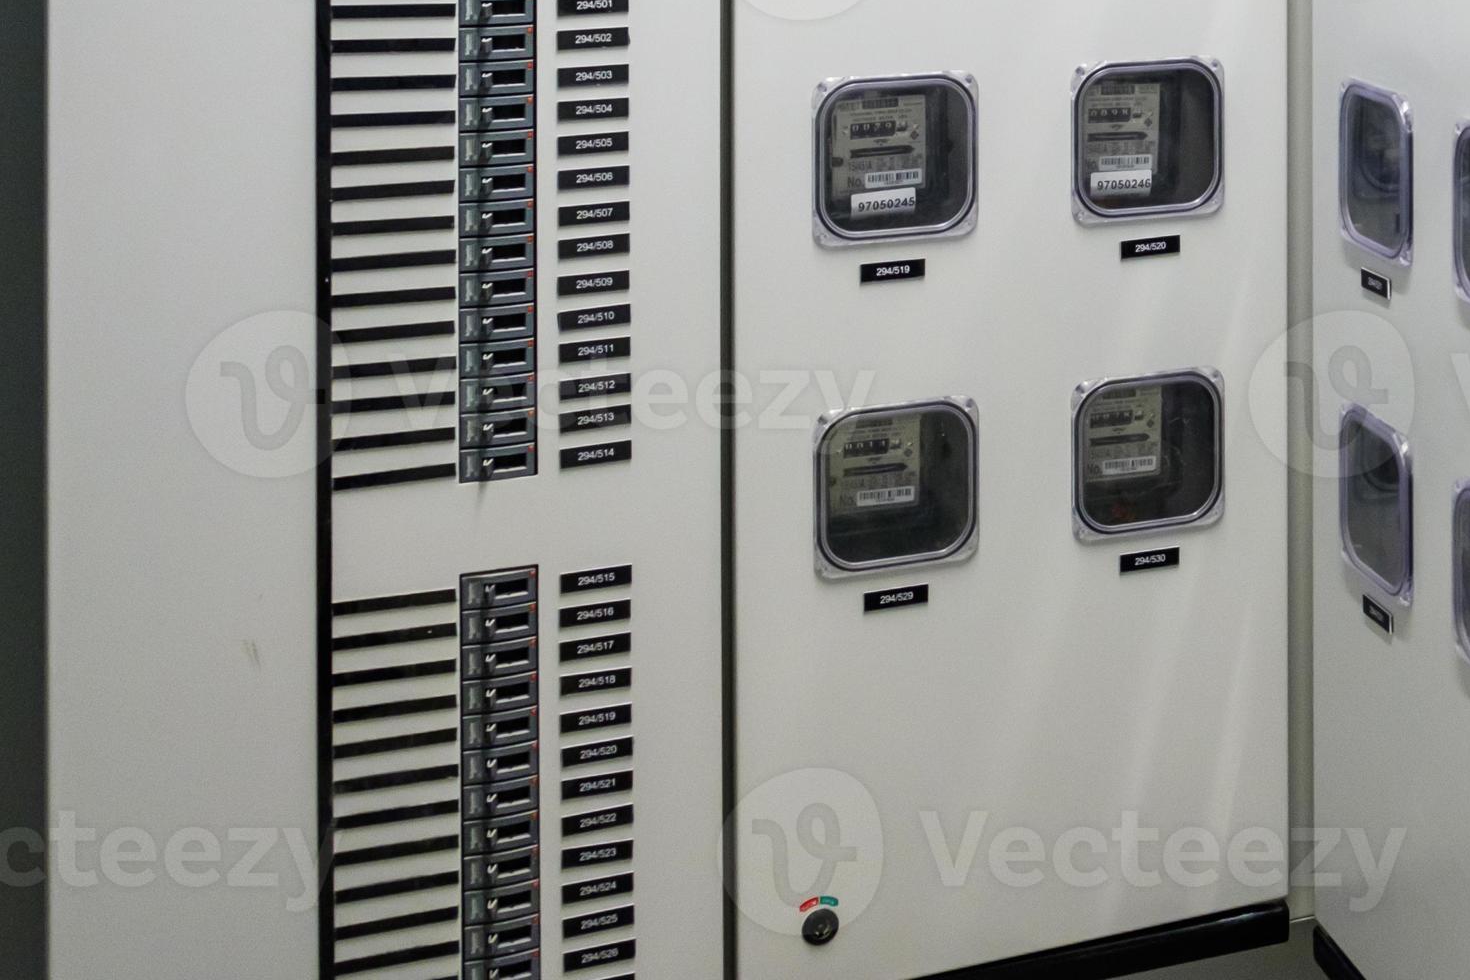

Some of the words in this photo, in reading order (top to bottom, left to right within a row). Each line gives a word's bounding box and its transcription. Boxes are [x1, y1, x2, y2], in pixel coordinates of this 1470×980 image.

[576, 0, 613, 11] 294/501
[574, 32, 613, 45] 294/502
[575, 70, 613, 82] 294/503
[575, 103, 613, 115] 294/504
[575, 137, 613, 150] 294/505
[575, 171, 614, 184] 294/506
[1097, 178, 1152, 190] 97050246
[858, 197, 916, 212] 97050245
[576, 207, 614, 220] 294/507
[576, 239, 614, 253] 294/508
[1134, 241, 1167, 253] 294/520
[875, 264, 911, 277] 294/519
[575, 276, 614, 290] 294/509
[577, 310, 615, 324] 294/510
[577, 343, 614, 357] 294/511
[578, 379, 616, 393] 294/512
[577, 411, 615, 426] 294/513
[577, 447, 615, 461] 294/514
[1134, 553, 1166, 566] 294/530
[577, 572, 616, 586] 294/515
[879, 591, 914, 605] 294/529
[576, 606, 615, 621] 294/516
[576, 639, 615, 655] 294/517
[578, 674, 616, 689] 294/518
[578, 711, 617, 726] 294/519
[579, 744, 618, 760] 294/520
